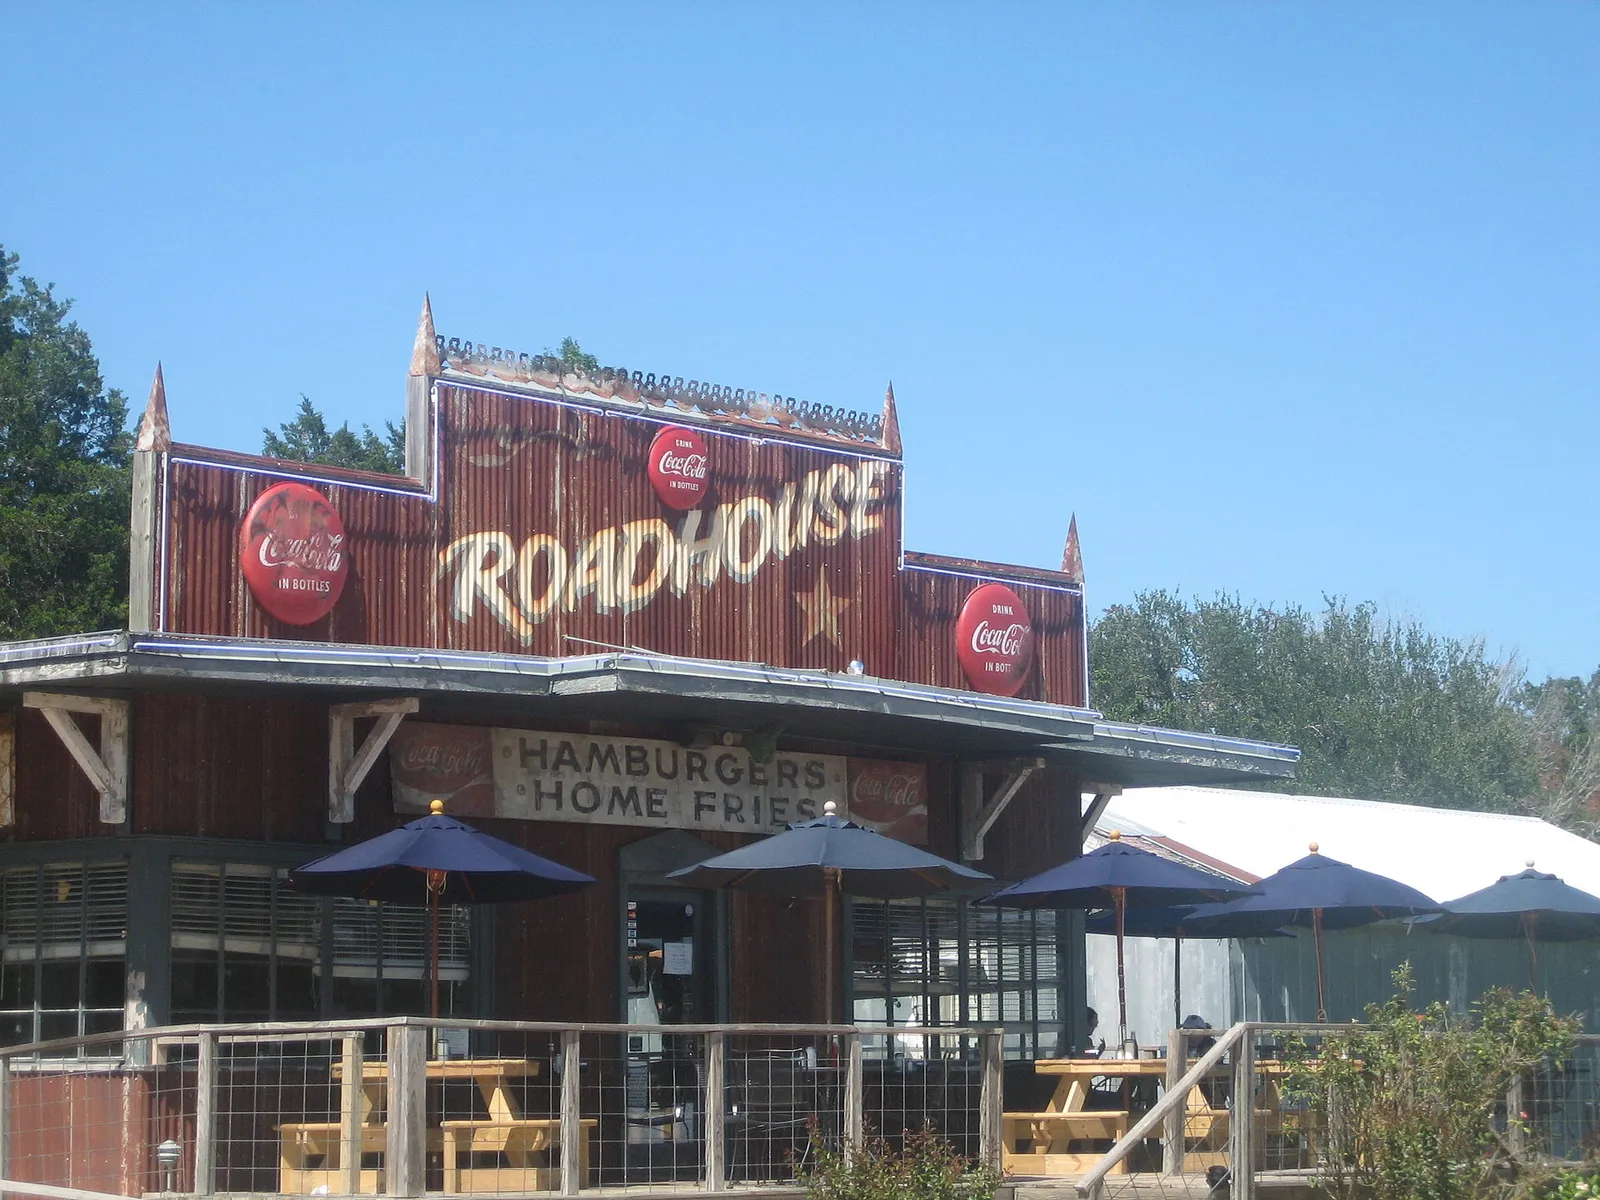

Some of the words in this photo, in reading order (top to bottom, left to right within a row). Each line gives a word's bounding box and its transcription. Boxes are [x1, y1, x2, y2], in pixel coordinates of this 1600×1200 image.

[676, 439, 693, 448] DRINK
[659, 450, 707, 479] Coca-Cola
[669, 480, 676, 488] IN
[677, 481, 699, 491] BOTTLES
[439, 458, 889, 647] ROADHOUSE
[278, 578, 290, 590] IN
[293, 579, 330, 593] BOTTLES
[992, 604, 1014, 616] DRINK
[985, 662, 994, 672] IN
[518, 736, 827, 790] HAMBURGERS
[852, 770, 922, 807] Coca-Cola
[534, 778, 668, 818] HOME
[692, 790, 818, 828] FRIES
